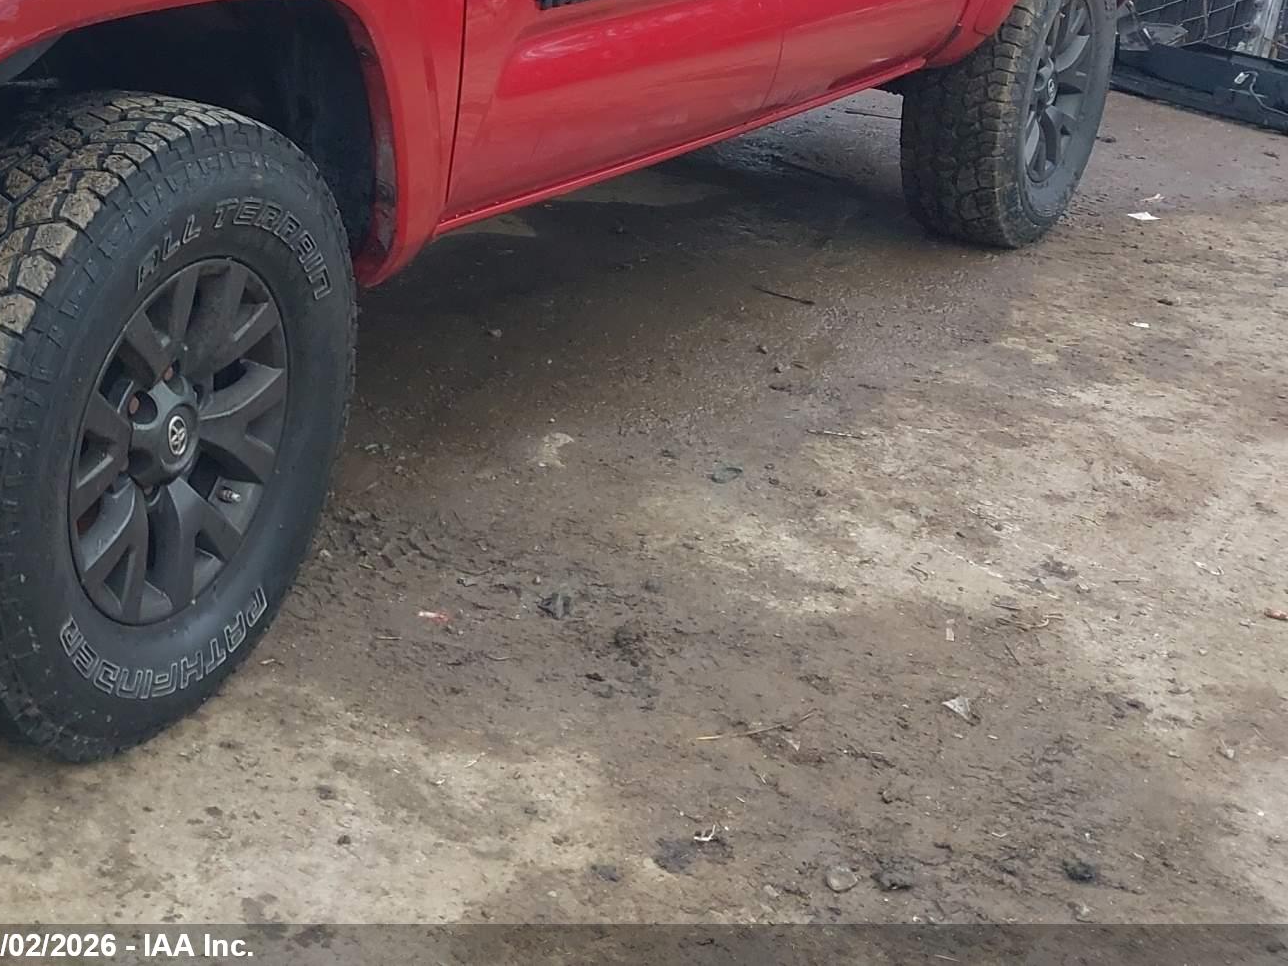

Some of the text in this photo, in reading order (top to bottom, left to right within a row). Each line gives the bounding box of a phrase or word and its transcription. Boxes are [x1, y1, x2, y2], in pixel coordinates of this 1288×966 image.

[136, 196, 333, 301] ALL TERRAIN
[59, 585, 268, 699] PATHFINDER
